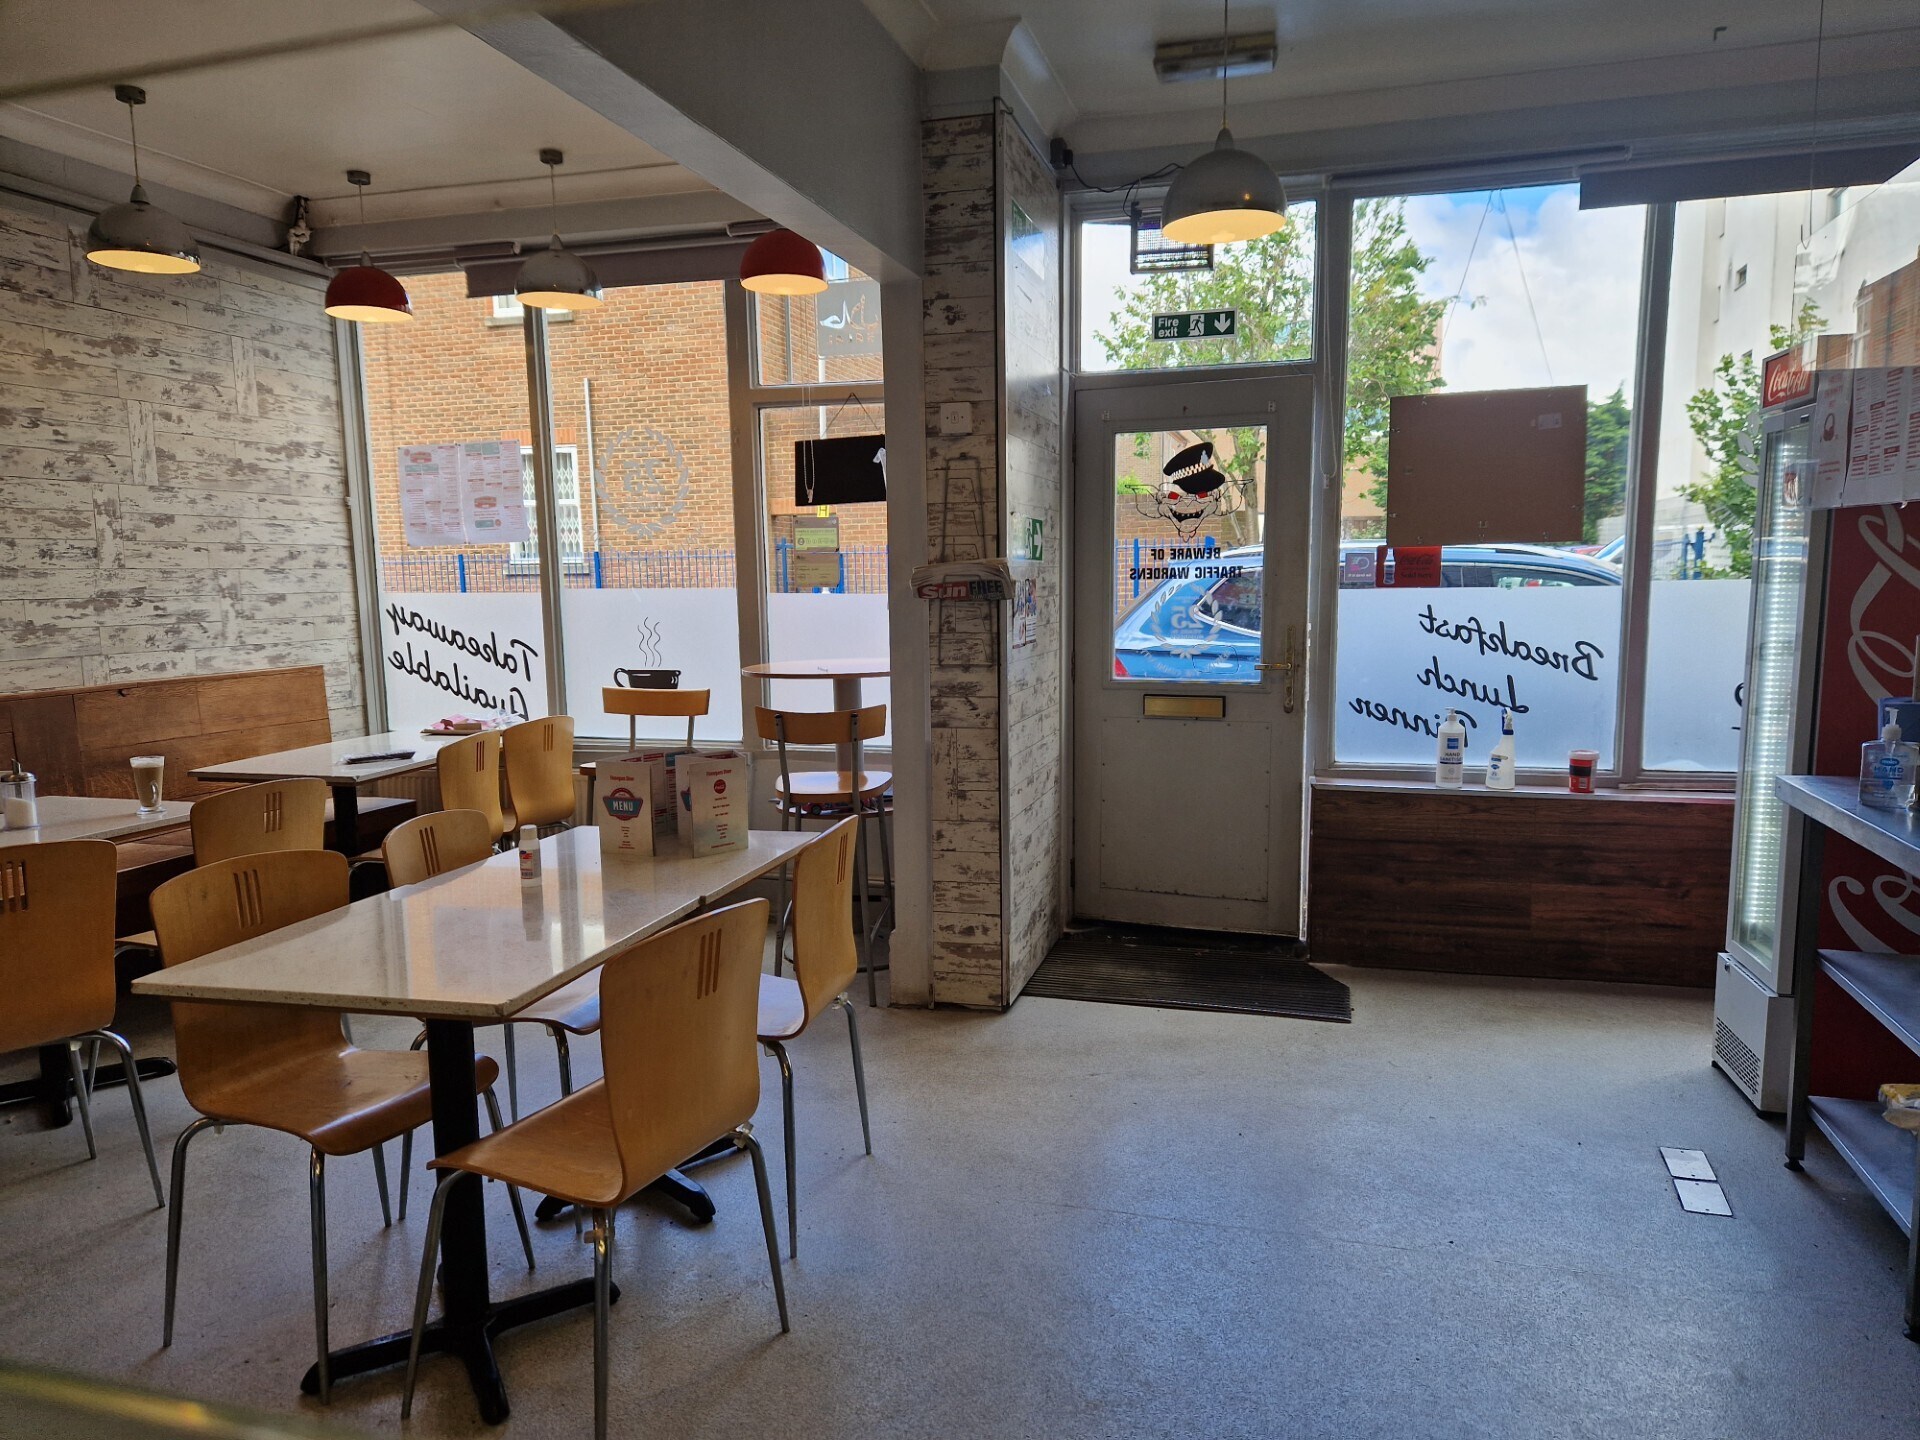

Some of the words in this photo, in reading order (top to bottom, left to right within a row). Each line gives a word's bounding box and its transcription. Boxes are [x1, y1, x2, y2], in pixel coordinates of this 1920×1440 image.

[1158, 317, 1180, 328] Fire
[1158, 327, 1178, 338] exit
[920, 584, 968, 600] Sun
[969, 580, 1002, 594] FREE
[1874, 765, 1904, 774] HAND
[612, 801, 634, 811] MENU
